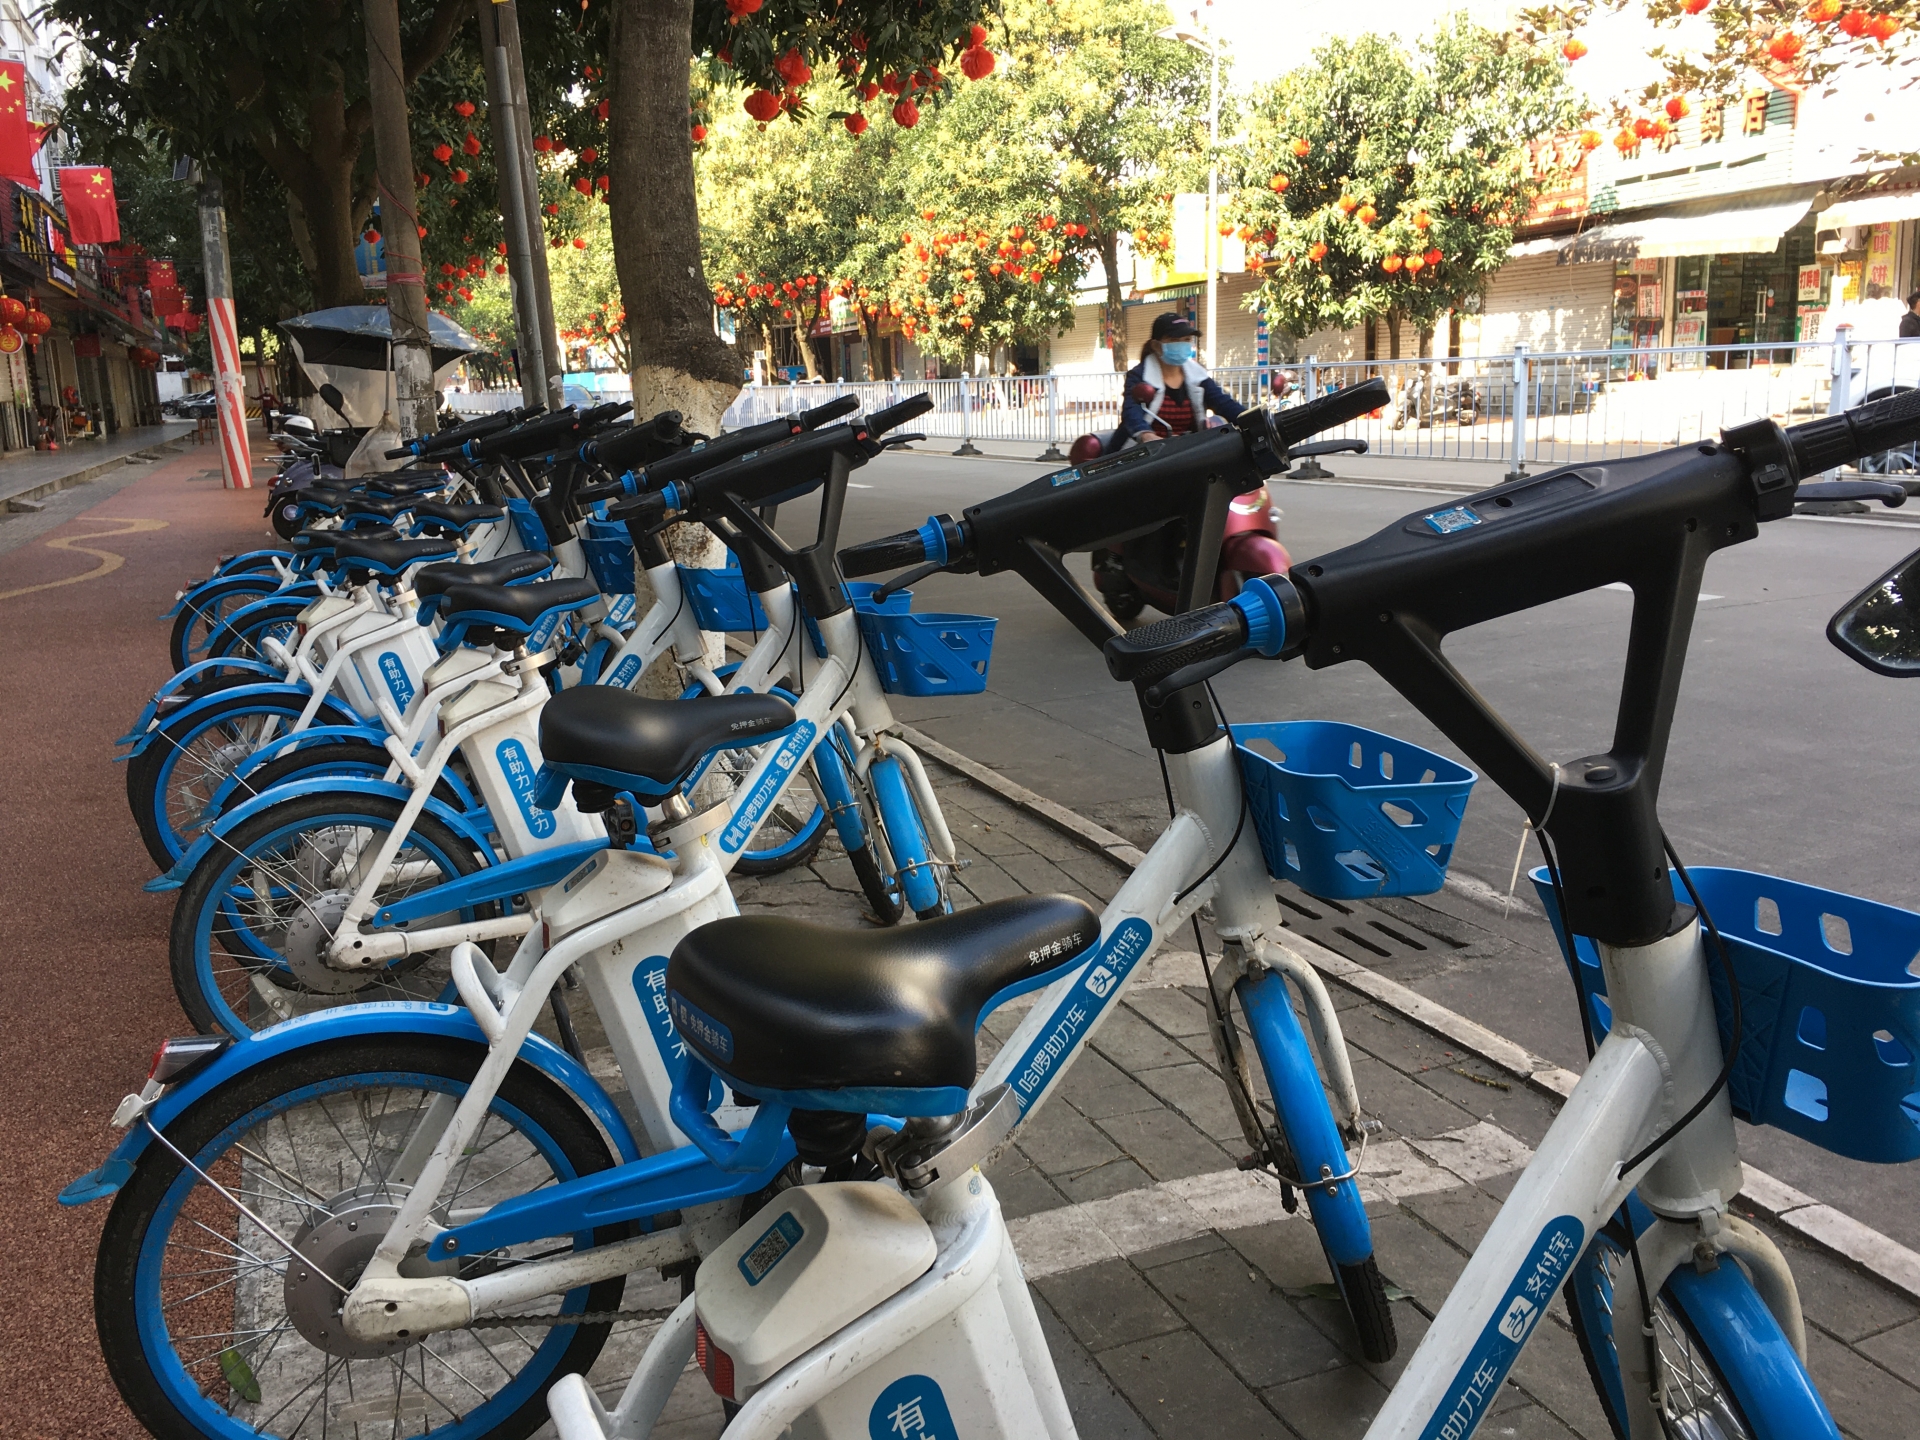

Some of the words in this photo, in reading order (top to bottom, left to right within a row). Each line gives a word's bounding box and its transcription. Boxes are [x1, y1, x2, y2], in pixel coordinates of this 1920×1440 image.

[383, 657, 412, 708] 有助力不
[788, 725, 809, 752] 支付宝
[1028, 932, 1083, 966] 免押金骑车
[1118, 935, 1144, 973] ALIPAY
[1018, 1003, 1086, 1093] 哈啰助力车
[1104, 926, 1140, 970] 支付宝
[690, 1013, 728, 1054] 免押金骑车
[1540, 1241, 1575, 1300] ALIPAY
[1435, 1358, 1498, 1440] 助力车
[1524, 1230, 1570, 1299] 支付宝
[886, 1395, 937, 1440] 有
